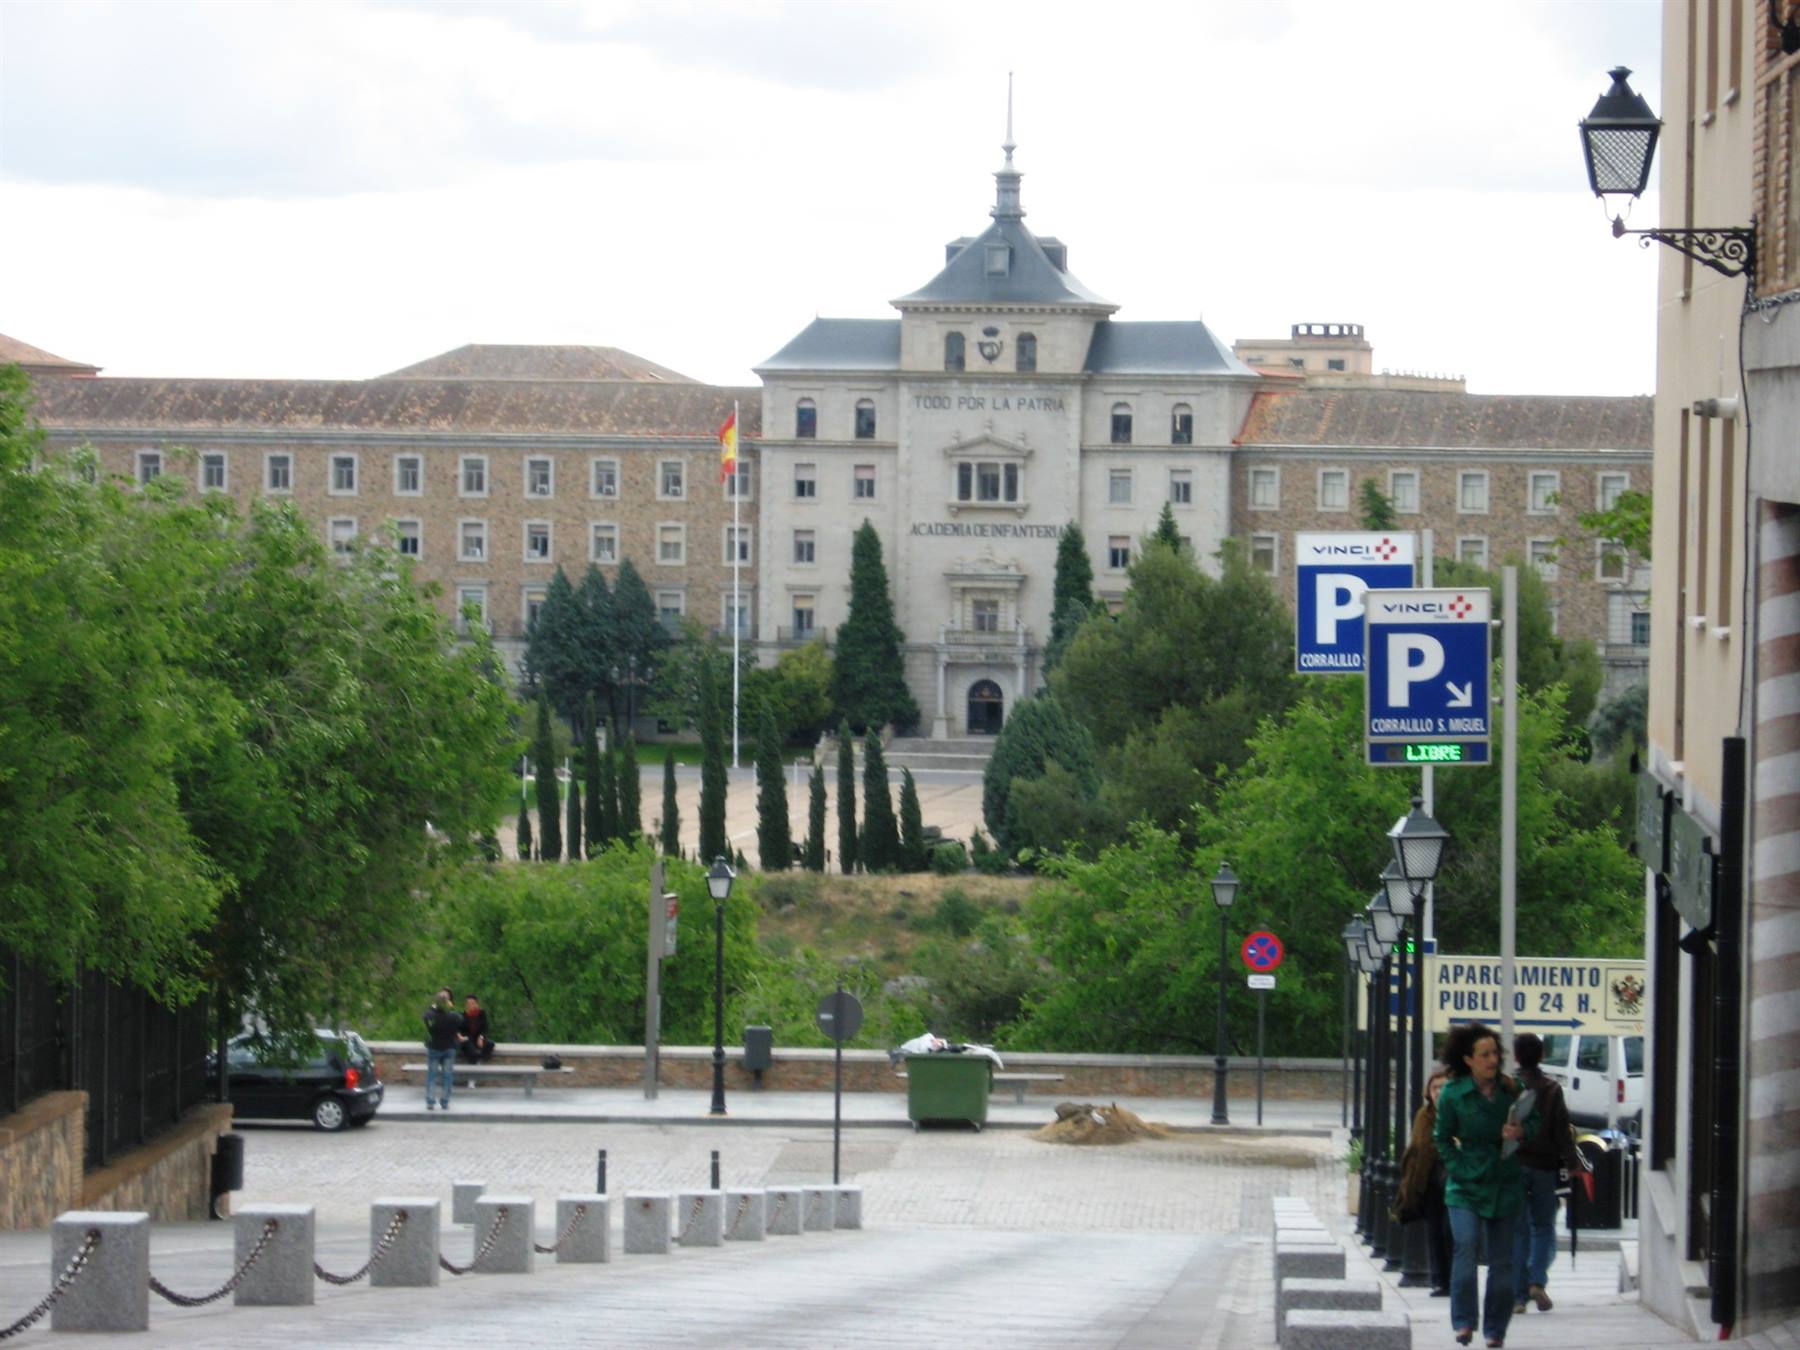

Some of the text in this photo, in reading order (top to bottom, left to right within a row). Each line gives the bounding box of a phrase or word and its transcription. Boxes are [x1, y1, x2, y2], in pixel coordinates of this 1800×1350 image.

[915, 395, 1065, 411] TODO POR LA PATRIA
[910, 522, 973, 537] ACADEMIA
[1313, 545, 1370, 555] VINCI
[1316, 573, 1368, 645] P
[1383, 603, 1443, 613] VINCI
[1300, 653, 1361, 668] CORRALILLO
[1387, 632, 1445, 708] P
[1371, 718, 1486, 733] CORRALILLO S. MIGUEL
[1406, 744, 1461, 761] LIBRE
[1439, 989, 1598, 1014] PUBLIO 24 H.
